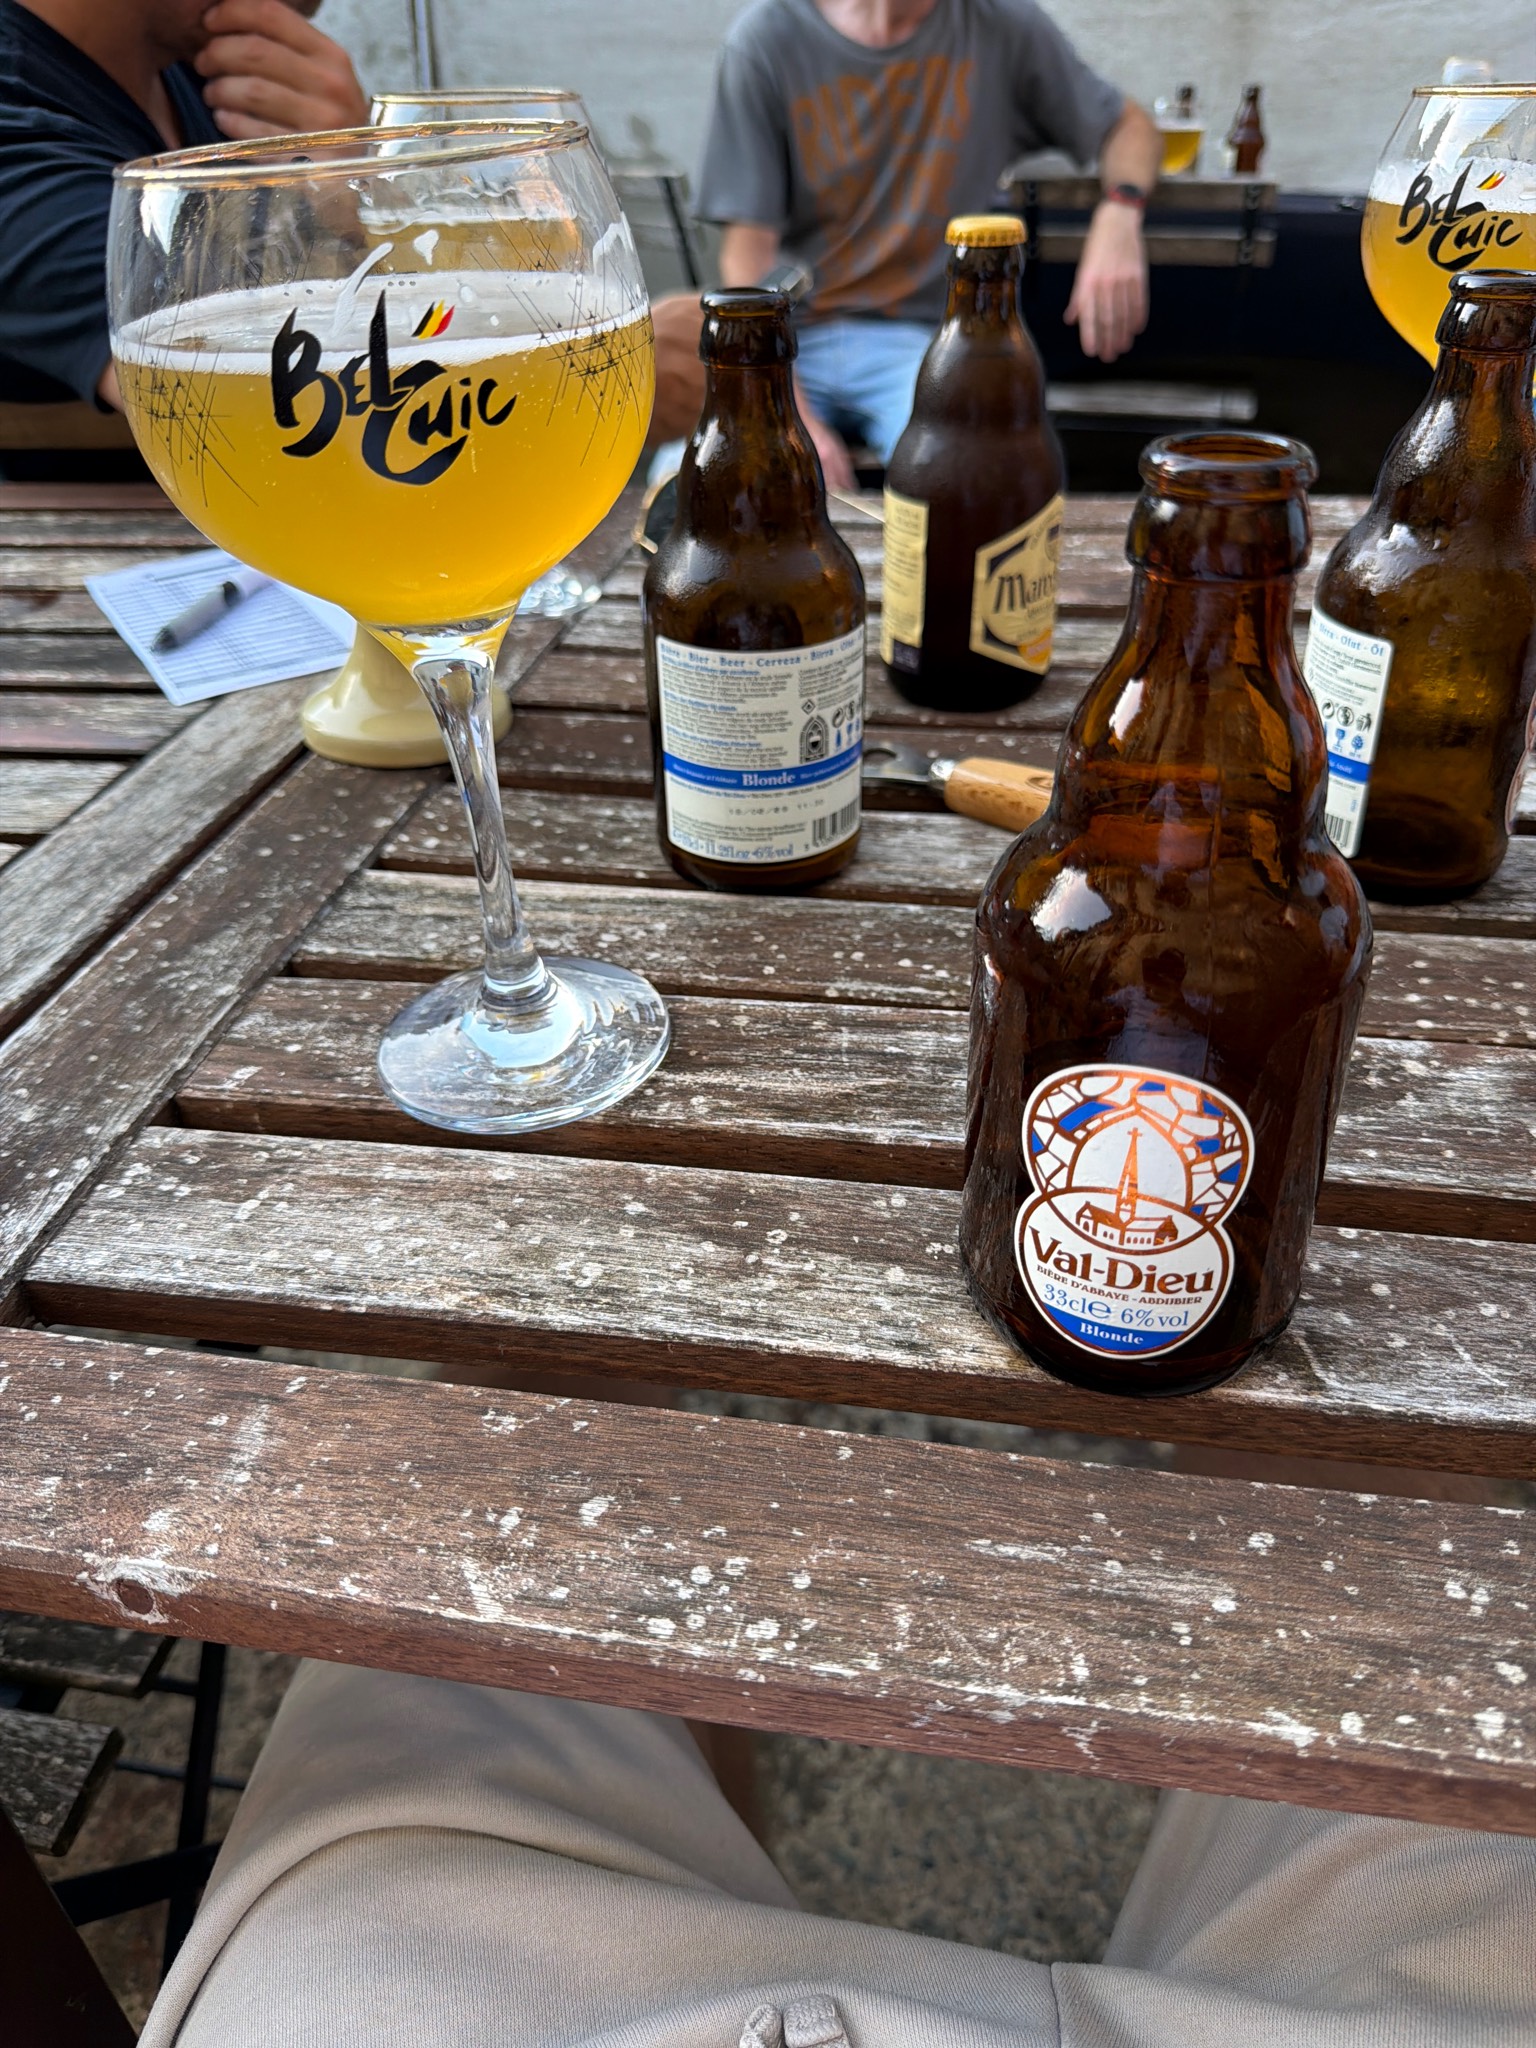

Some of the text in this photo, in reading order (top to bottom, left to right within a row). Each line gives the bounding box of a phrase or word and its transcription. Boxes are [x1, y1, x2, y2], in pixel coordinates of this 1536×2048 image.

[719, 656, 745, 667] Beer
[756, 656, 800, 668] Cerveza
[741, 771, 796, 787] Blonde
[1028, 1225, 1215, 1295] Val-Dieu
[1070, 1280, 1130, 1302] D'ABBAYE
[1138, 1296, 1203, 1306] ABDIJBIER
[1158, 1310, 1189, 1327] vol
[1079, 1321, 1144, 1345] Blonde
